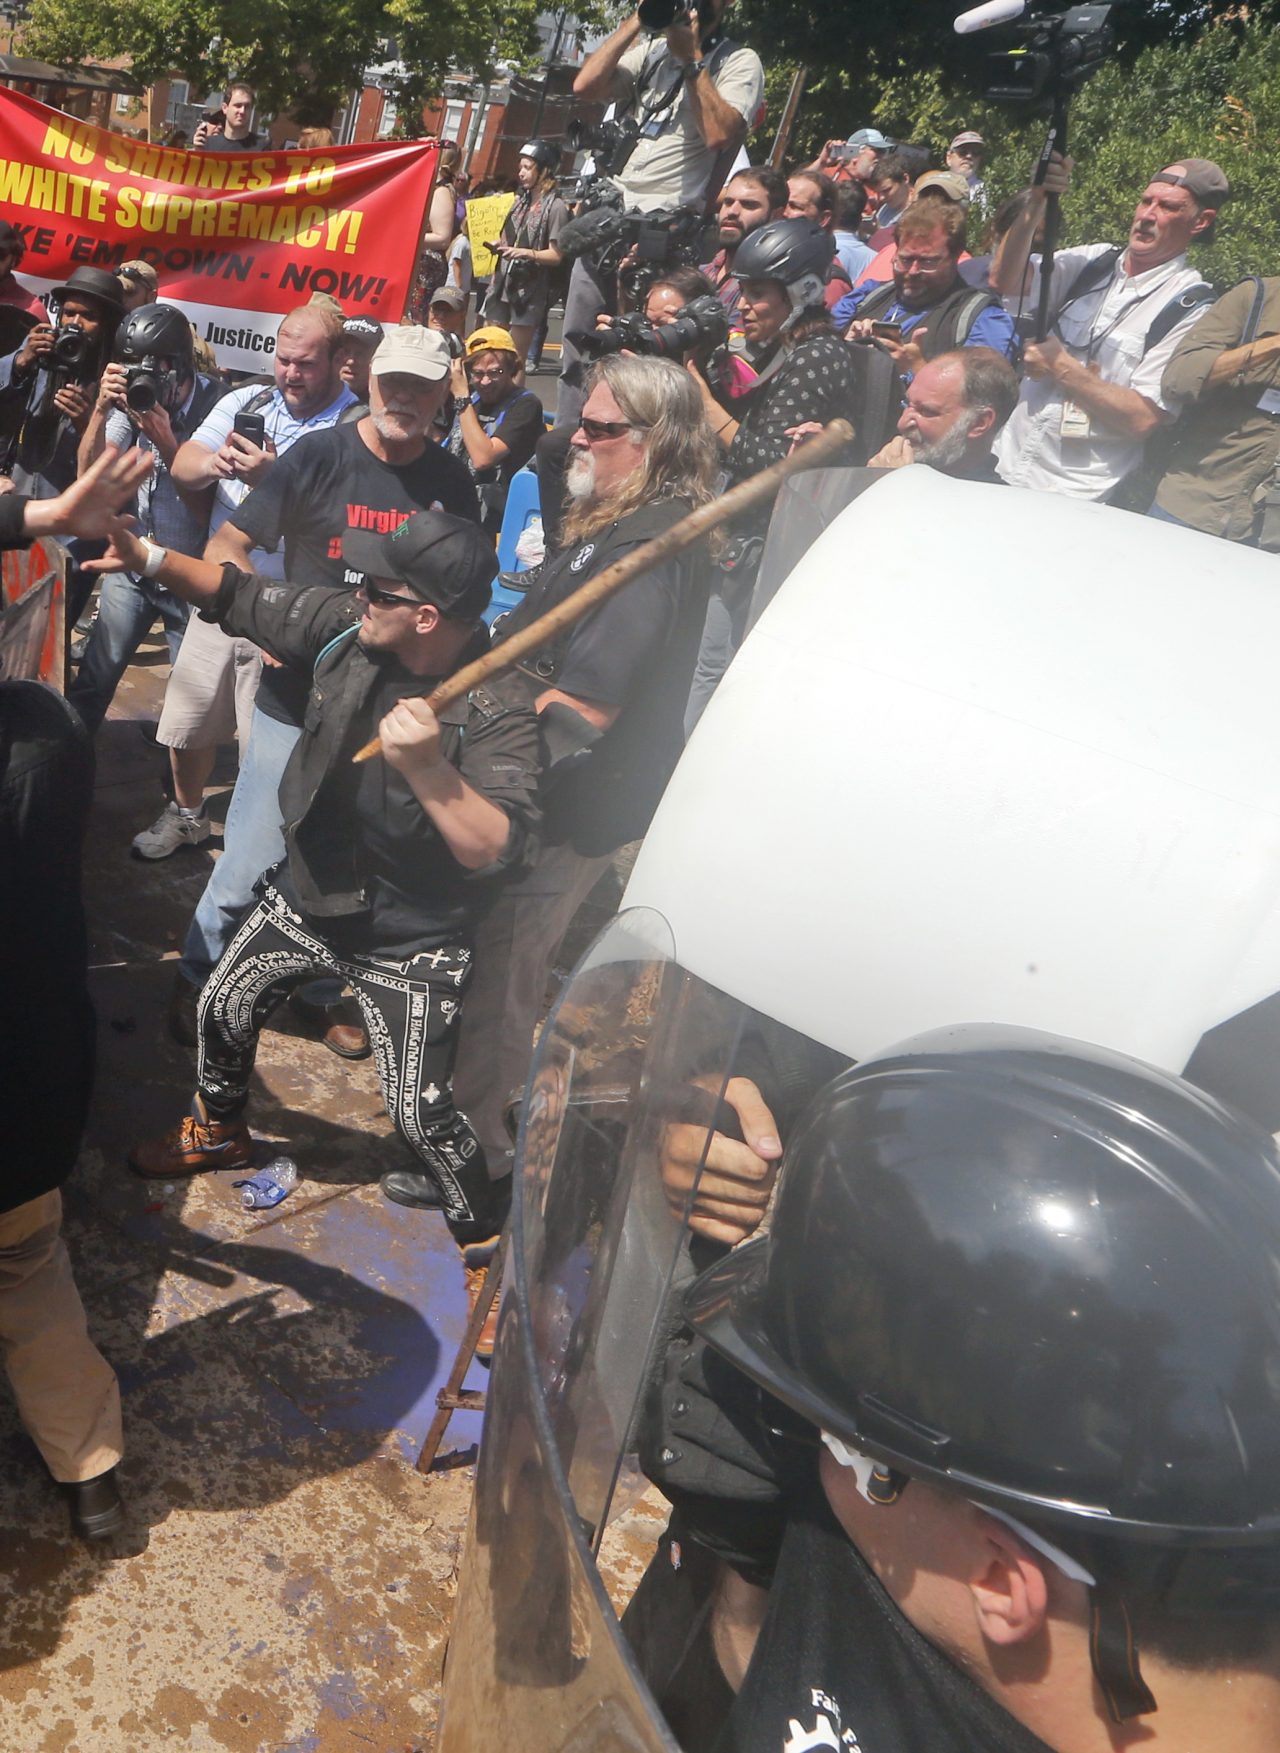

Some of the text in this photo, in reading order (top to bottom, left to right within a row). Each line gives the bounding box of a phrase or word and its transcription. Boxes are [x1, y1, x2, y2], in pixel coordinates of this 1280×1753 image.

[41, 116, 337, 195] NO SHRINES TO
[115, 186, 364, 254] SUPREMACY!
[136, 244, 255, 282] DOWN
[278, 262, 388, 305] NOW!
[205, 321, 276, 354] Justice
[344, 569, 365, 585] for
